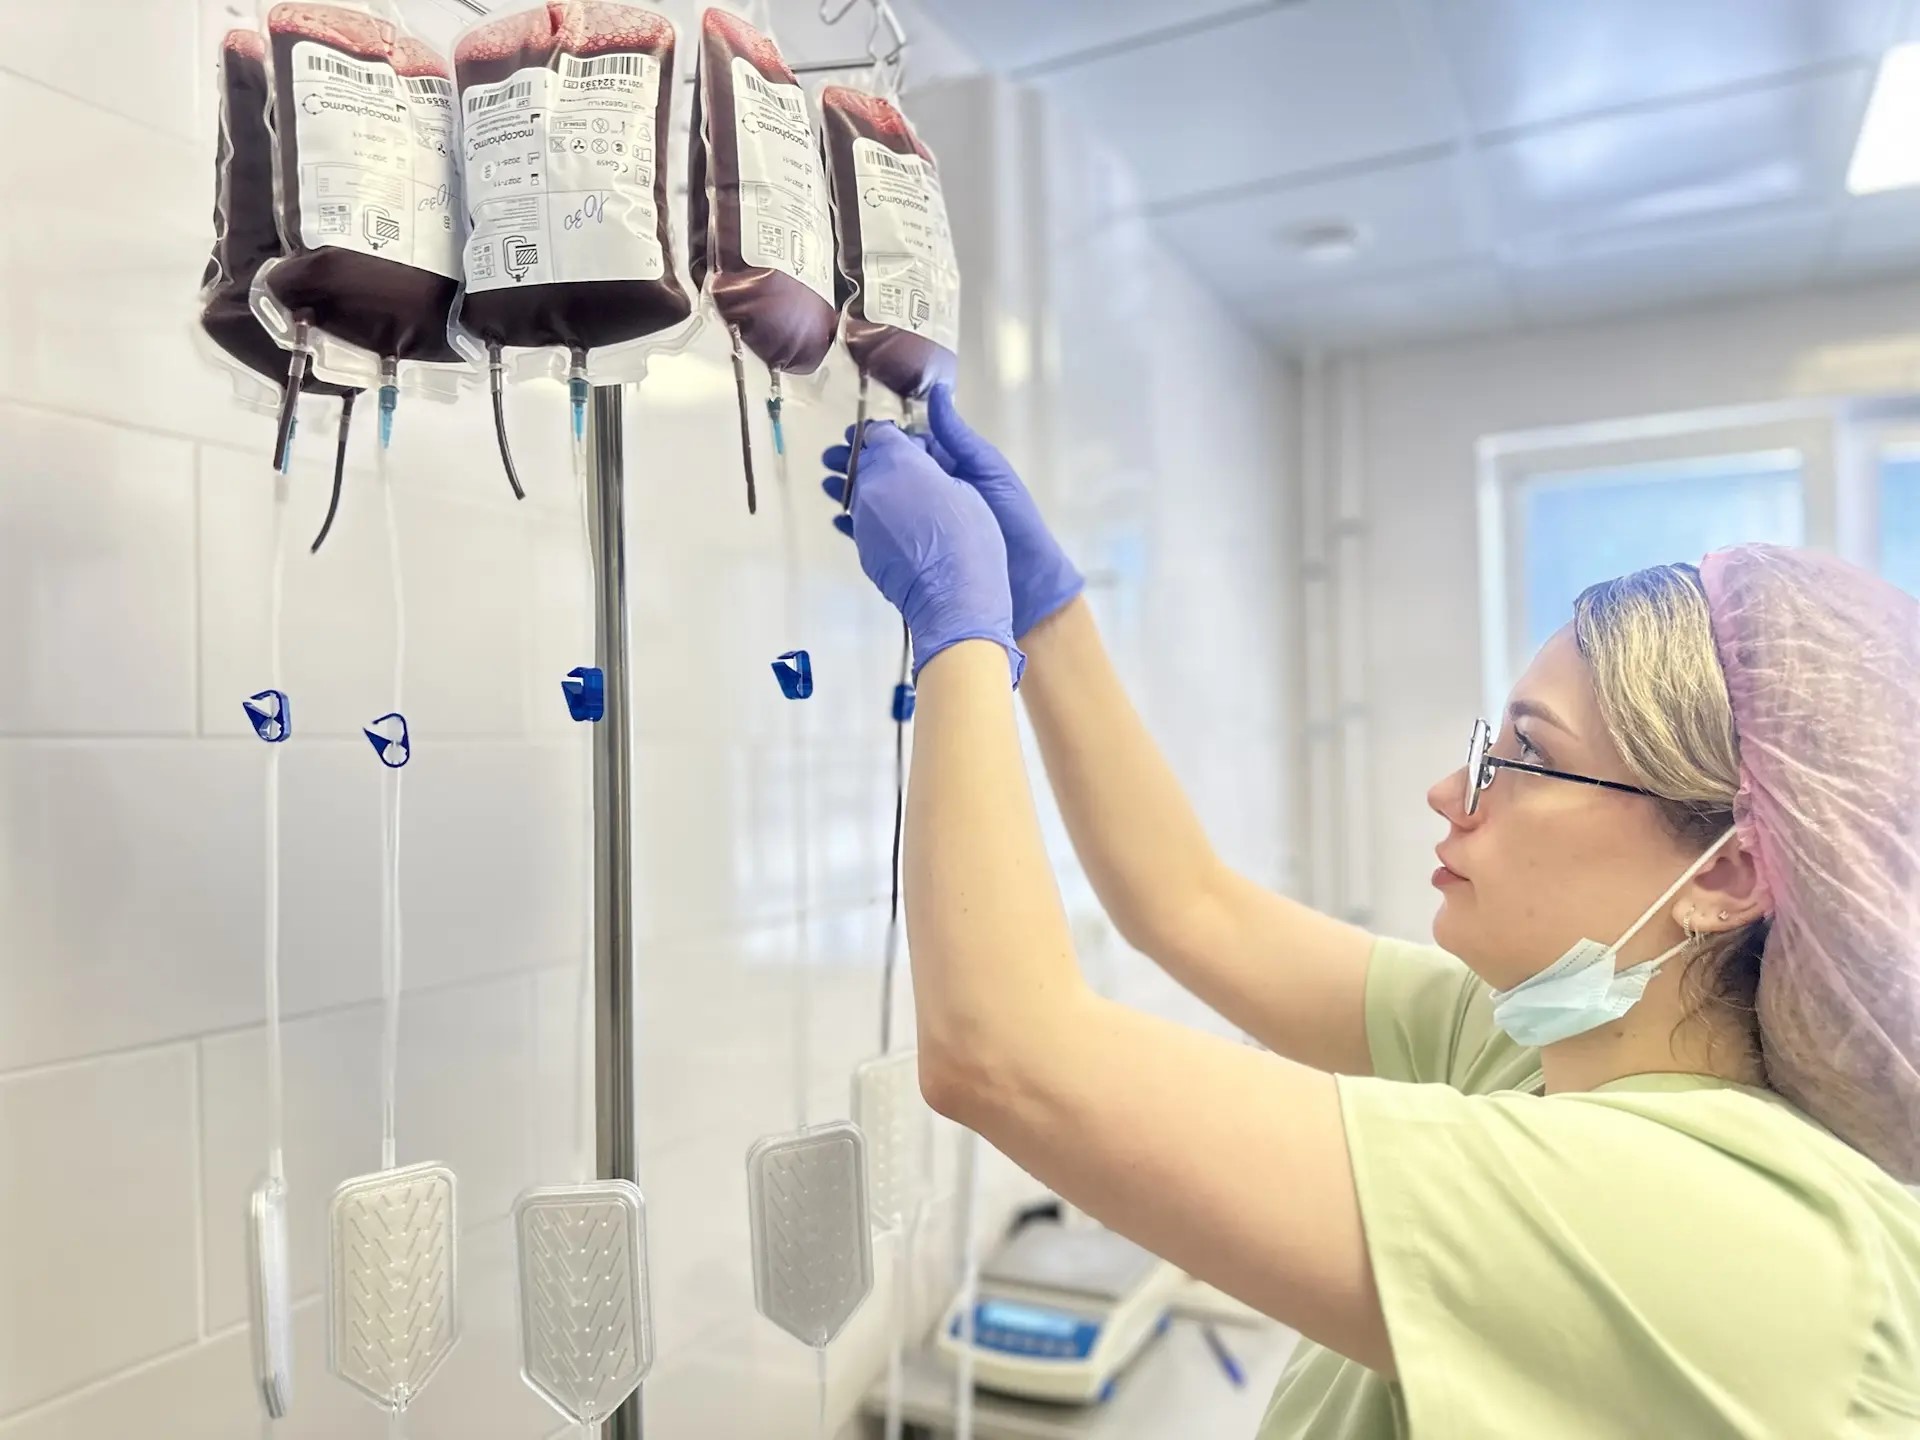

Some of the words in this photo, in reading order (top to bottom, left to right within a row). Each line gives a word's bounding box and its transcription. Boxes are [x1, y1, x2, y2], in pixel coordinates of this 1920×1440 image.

[580, 78, 616, 89] 324393
[320, 101, 401, 123] macopharma
[473, 127, 534, 151] macopharma
[757, 120, 809, 150] macopharma
[495, 156, 521, 167] 2025-1
[493, 177, 522, 188] 2027-11
[877, 195, 928, 214] macopharma
